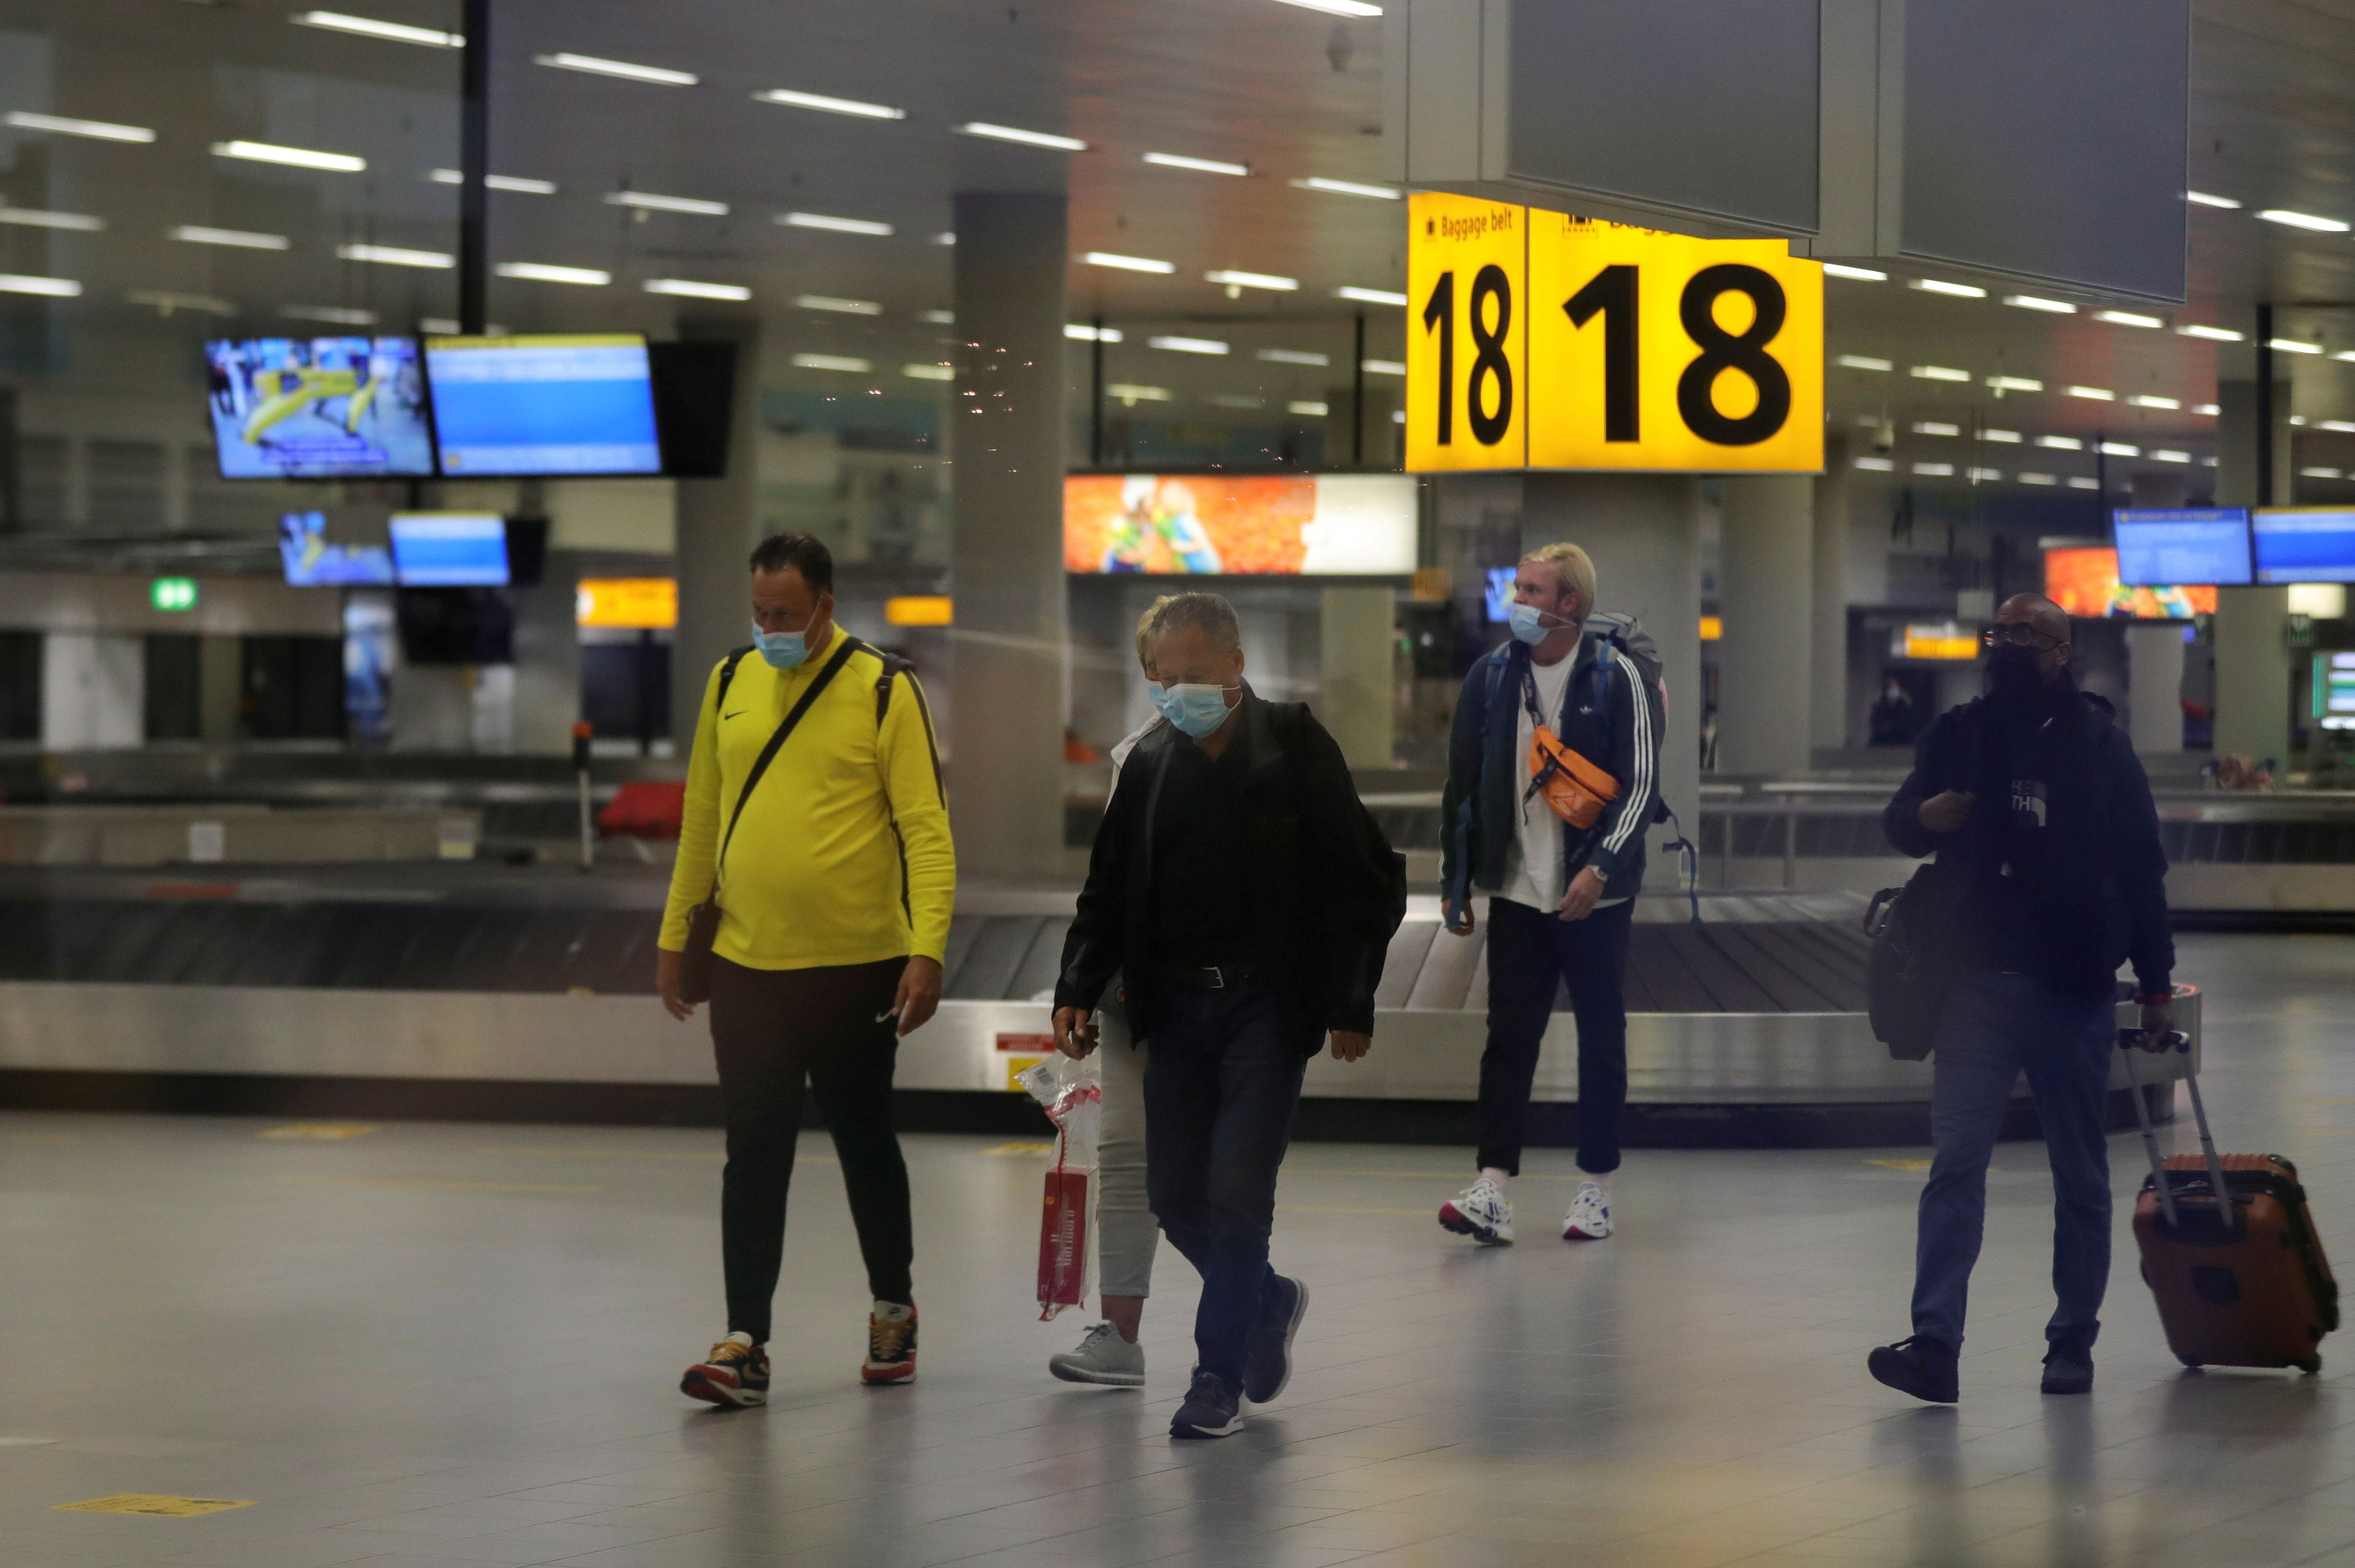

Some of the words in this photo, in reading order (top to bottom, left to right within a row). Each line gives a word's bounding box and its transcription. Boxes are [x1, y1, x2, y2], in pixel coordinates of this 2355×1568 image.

[1442, 215, 1487, 242] Baggage
[1491, 207, 1512, 231] belt
[1423, 263, 1513, 446] 18
[1562, 263, 1791, 446] 18
